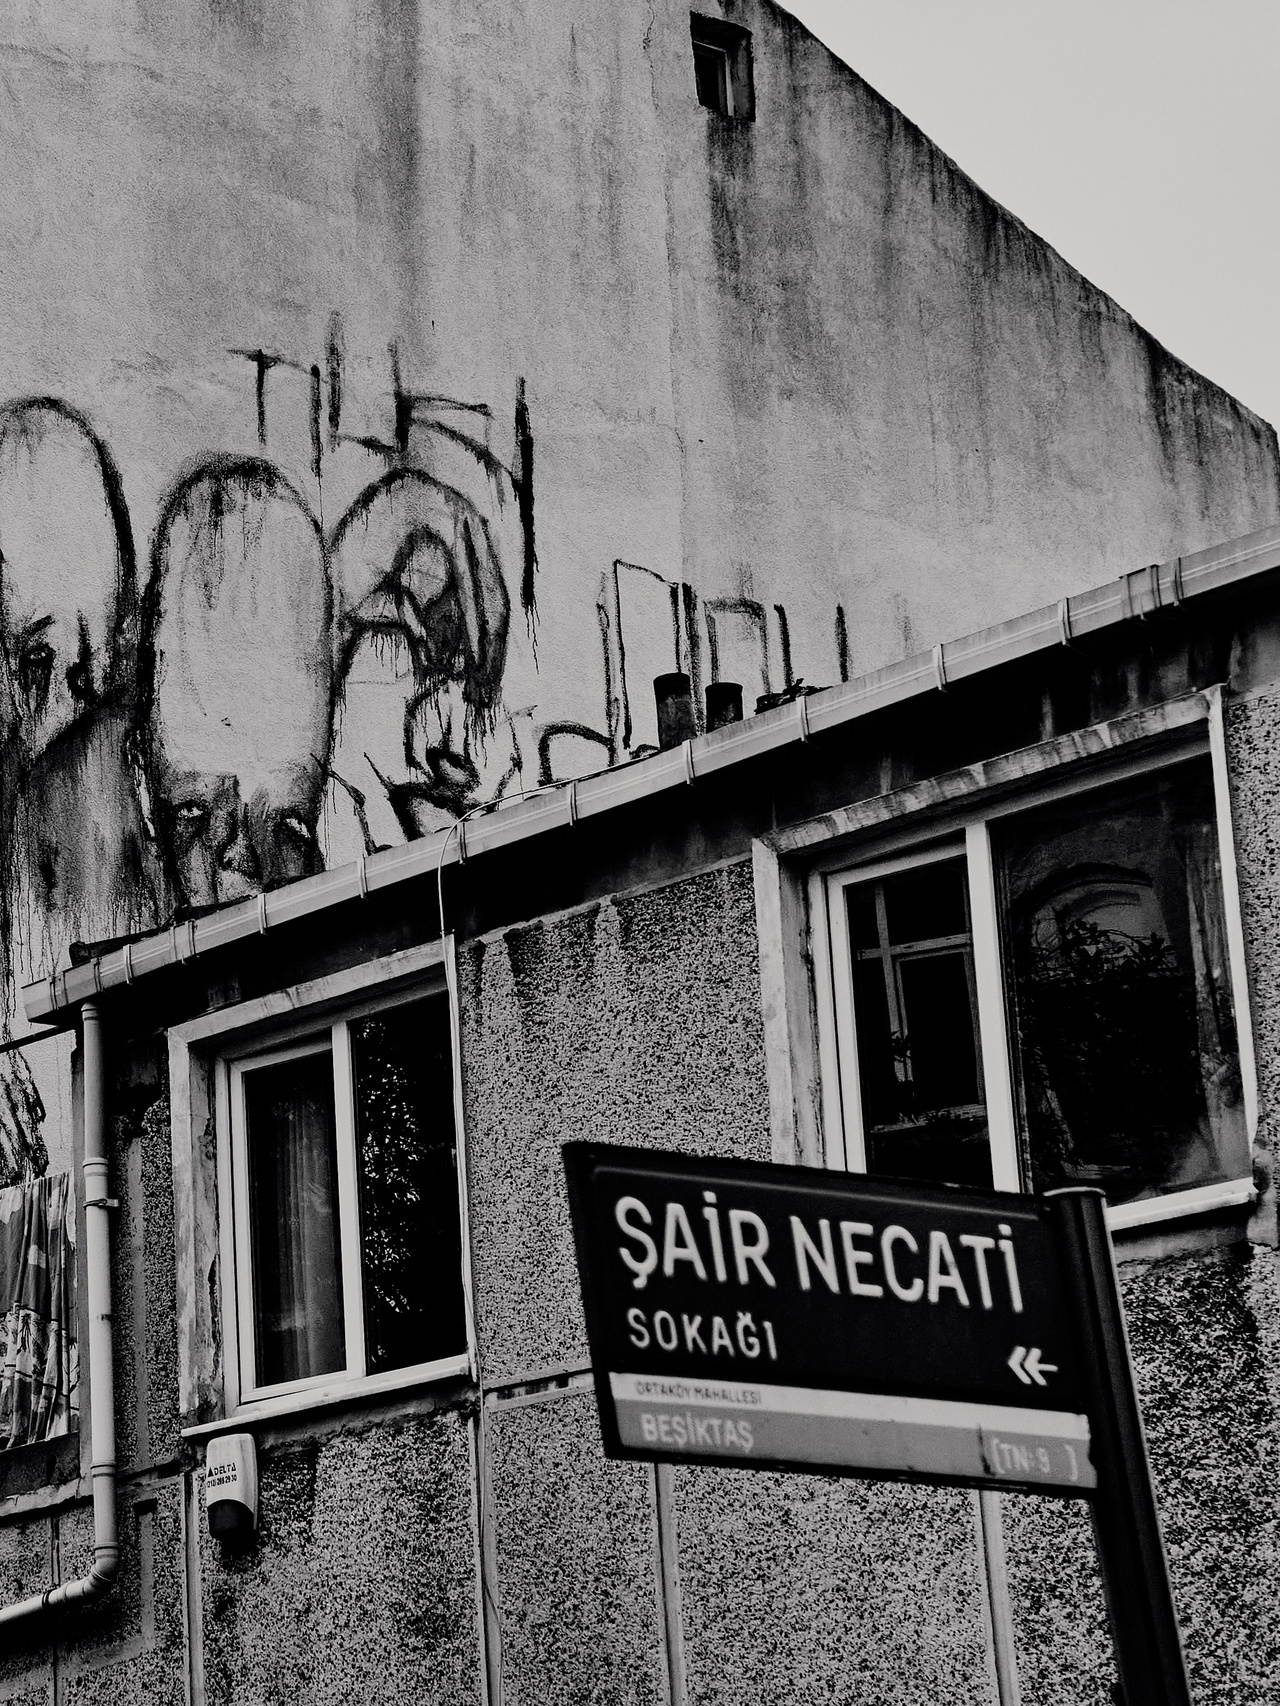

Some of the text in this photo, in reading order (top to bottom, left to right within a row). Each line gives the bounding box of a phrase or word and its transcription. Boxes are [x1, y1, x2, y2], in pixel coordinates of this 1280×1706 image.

[615, 1191, 1023, 1312] ŞAİR NECATİ
[627, 1308, 778, 1361] SOKAĞI
[641, 1413, 755, 1454] BEŞİKTAŞ
